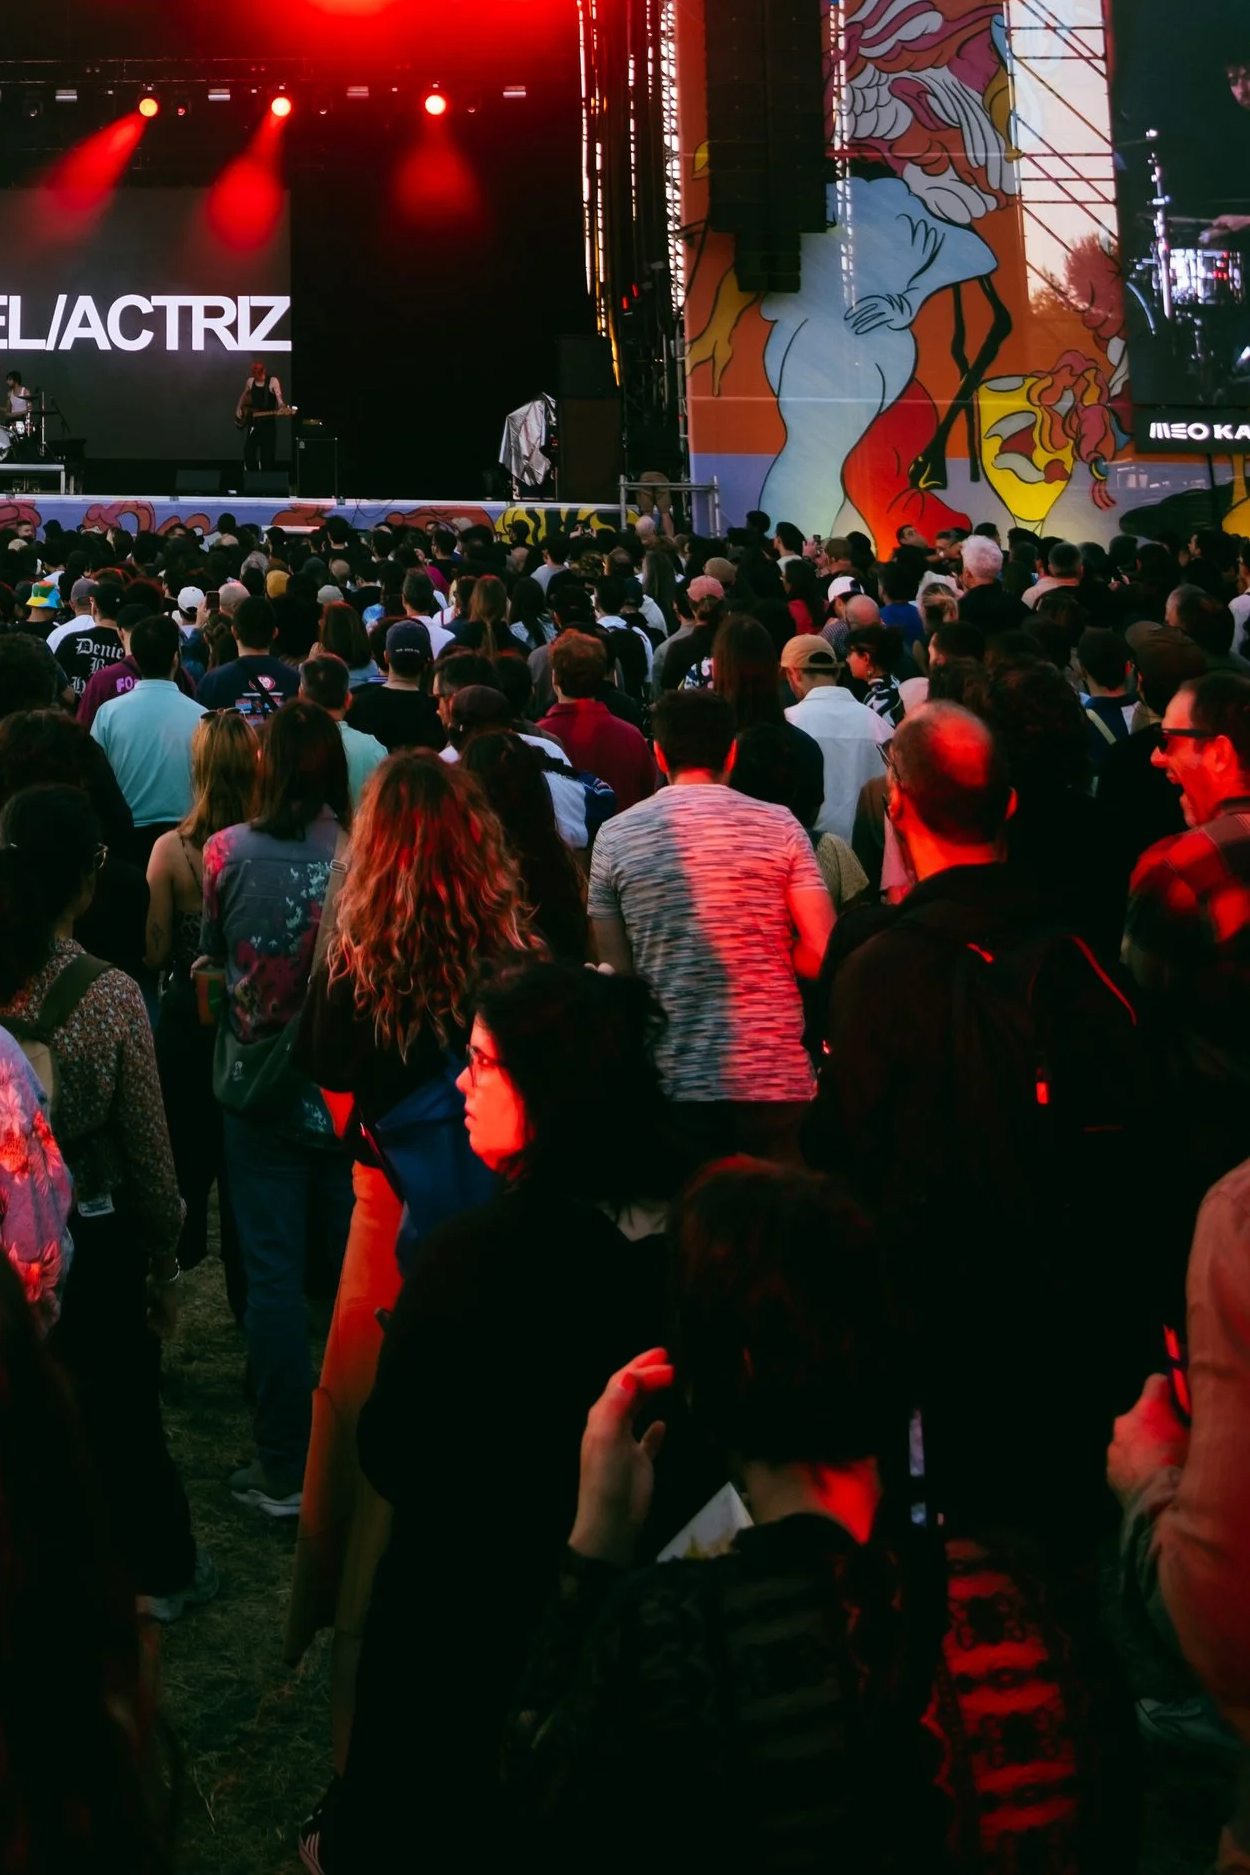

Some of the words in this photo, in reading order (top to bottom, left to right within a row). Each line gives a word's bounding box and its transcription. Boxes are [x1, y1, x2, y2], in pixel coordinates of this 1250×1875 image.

[1149, 422, 1210, 440] MEO
[75, 638, 124, 660] Denie
[116, 676, 135, 693] FO
